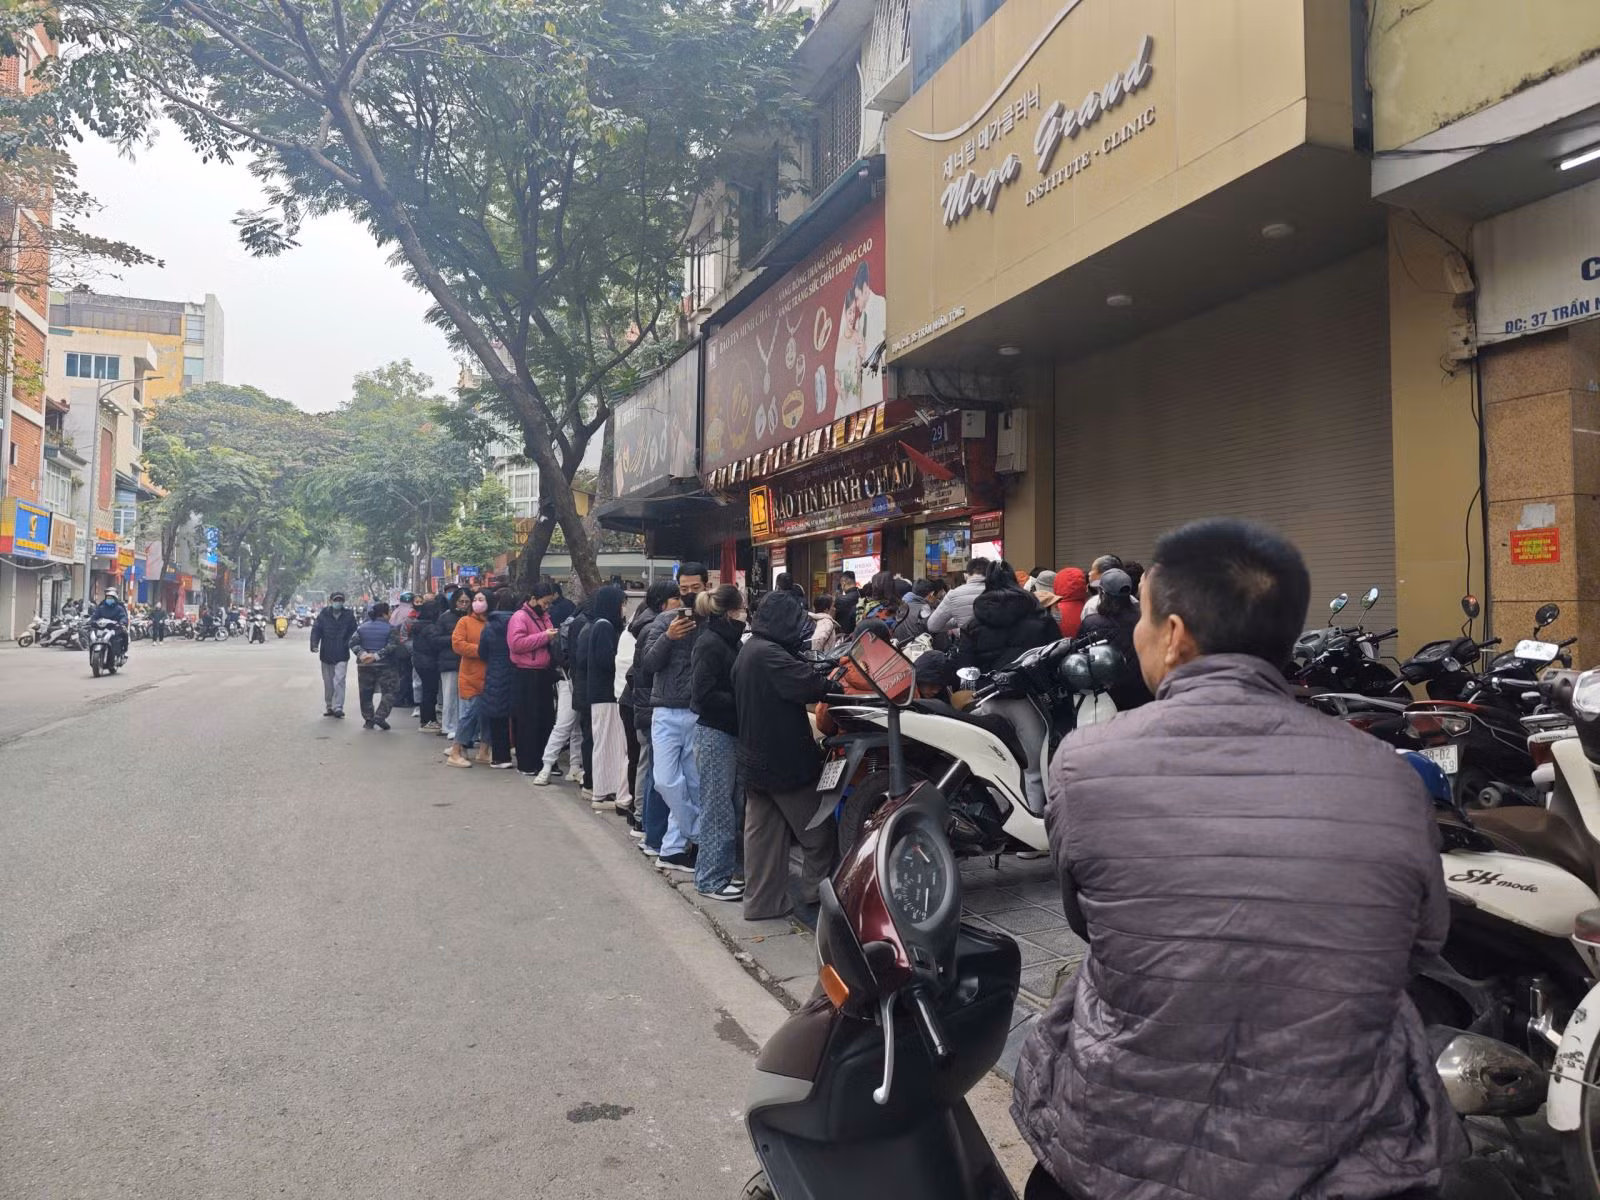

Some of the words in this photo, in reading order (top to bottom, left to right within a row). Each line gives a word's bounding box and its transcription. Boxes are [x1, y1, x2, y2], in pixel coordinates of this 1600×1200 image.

[940, 152, 1023, 228] Mega
[1034, 34, 1154, 174] Grand
[1025, 150, 1092, 207] INSTITUTE
[1102, 106, 1157, 154] CLINIC
[857, 237, 873, 259] CAO
[1505, 318, 1528, 334] ĐC:
[1531, 312, 1547, 327] 37
[1552, 298, 1590, 321] TRẦN
[932, 426, 943, 442] 29
[821, 475, 863, 510] MINH
[1449, 869, 1504, 885] SH
[1496, 880, 1539, 893] mode
